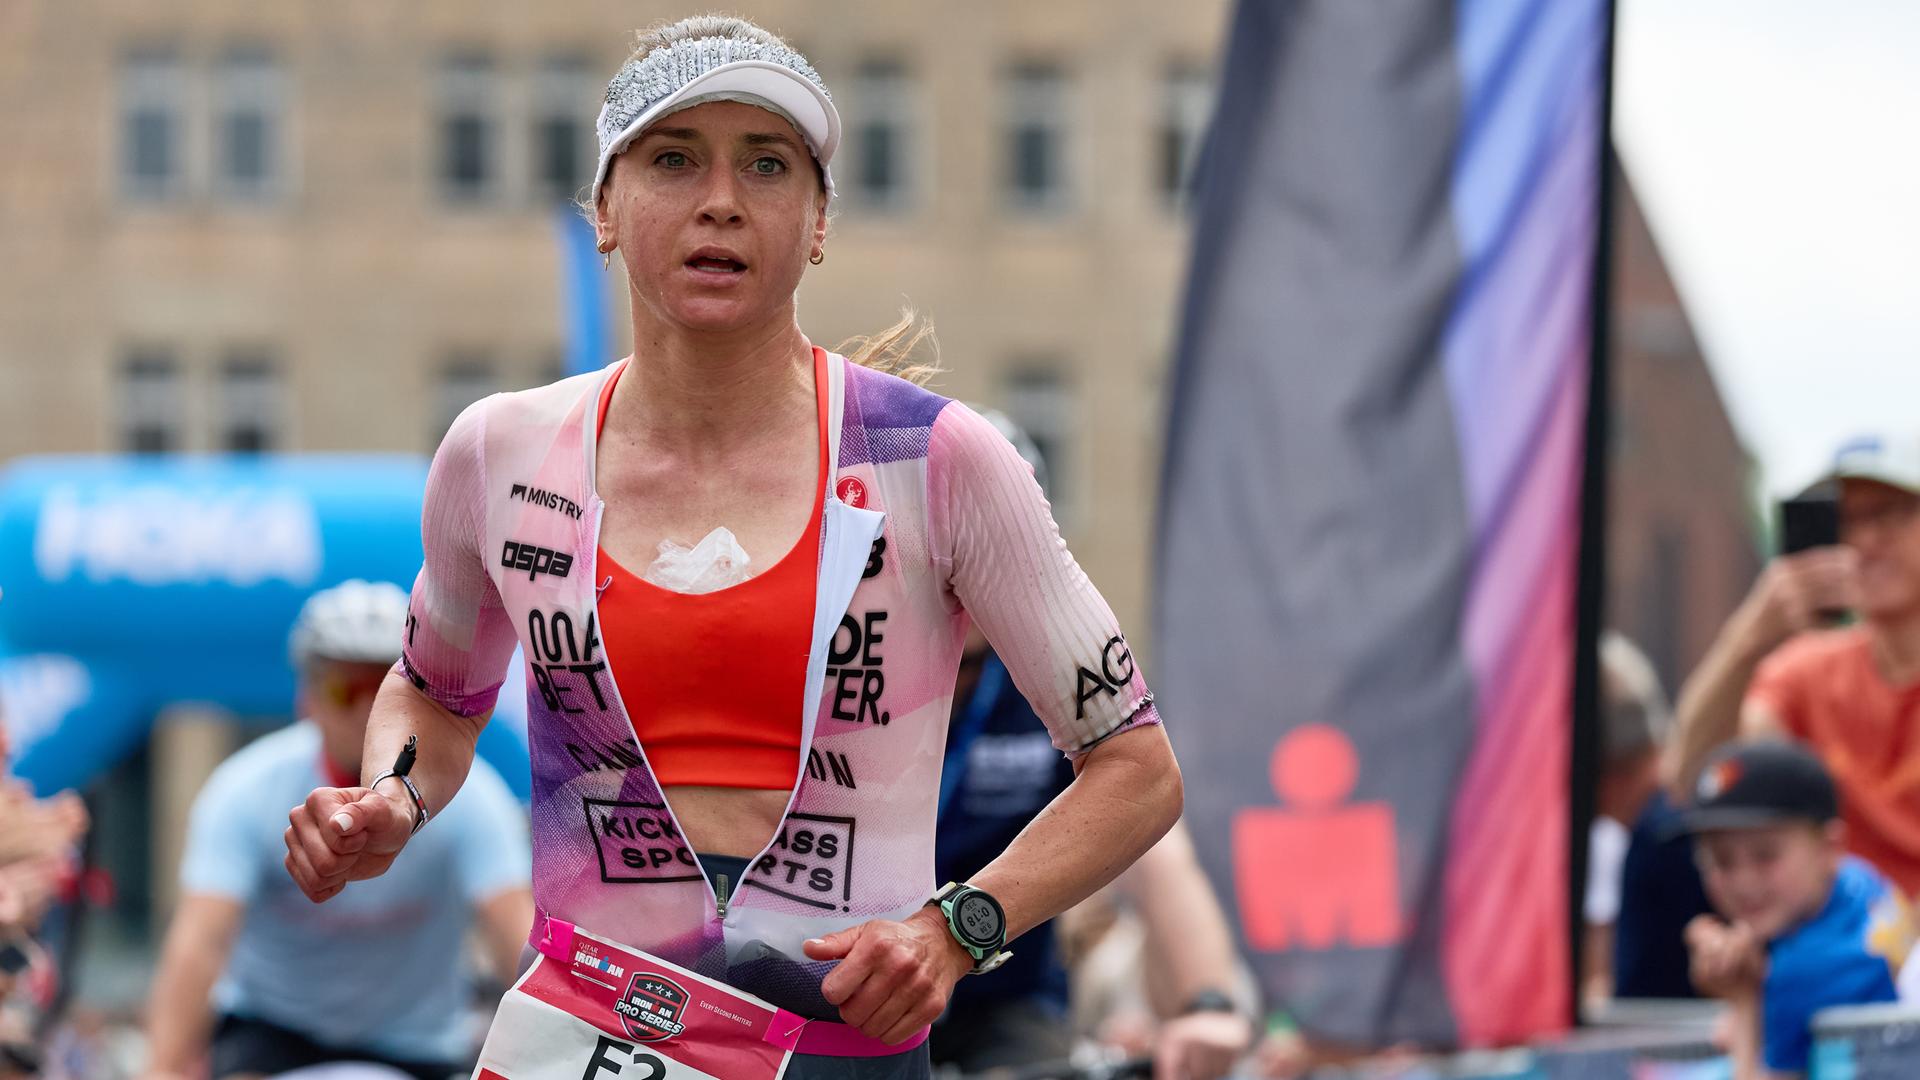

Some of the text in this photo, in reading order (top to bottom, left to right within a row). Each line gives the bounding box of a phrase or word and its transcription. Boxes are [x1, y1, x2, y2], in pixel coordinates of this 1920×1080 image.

[527, 487, 584, 521] MNSTRY
[501, 541, 574, 582] ospa
[531, 660, 608, 714] BET
[616, 1001, 683, 1035] PRO SERIES
